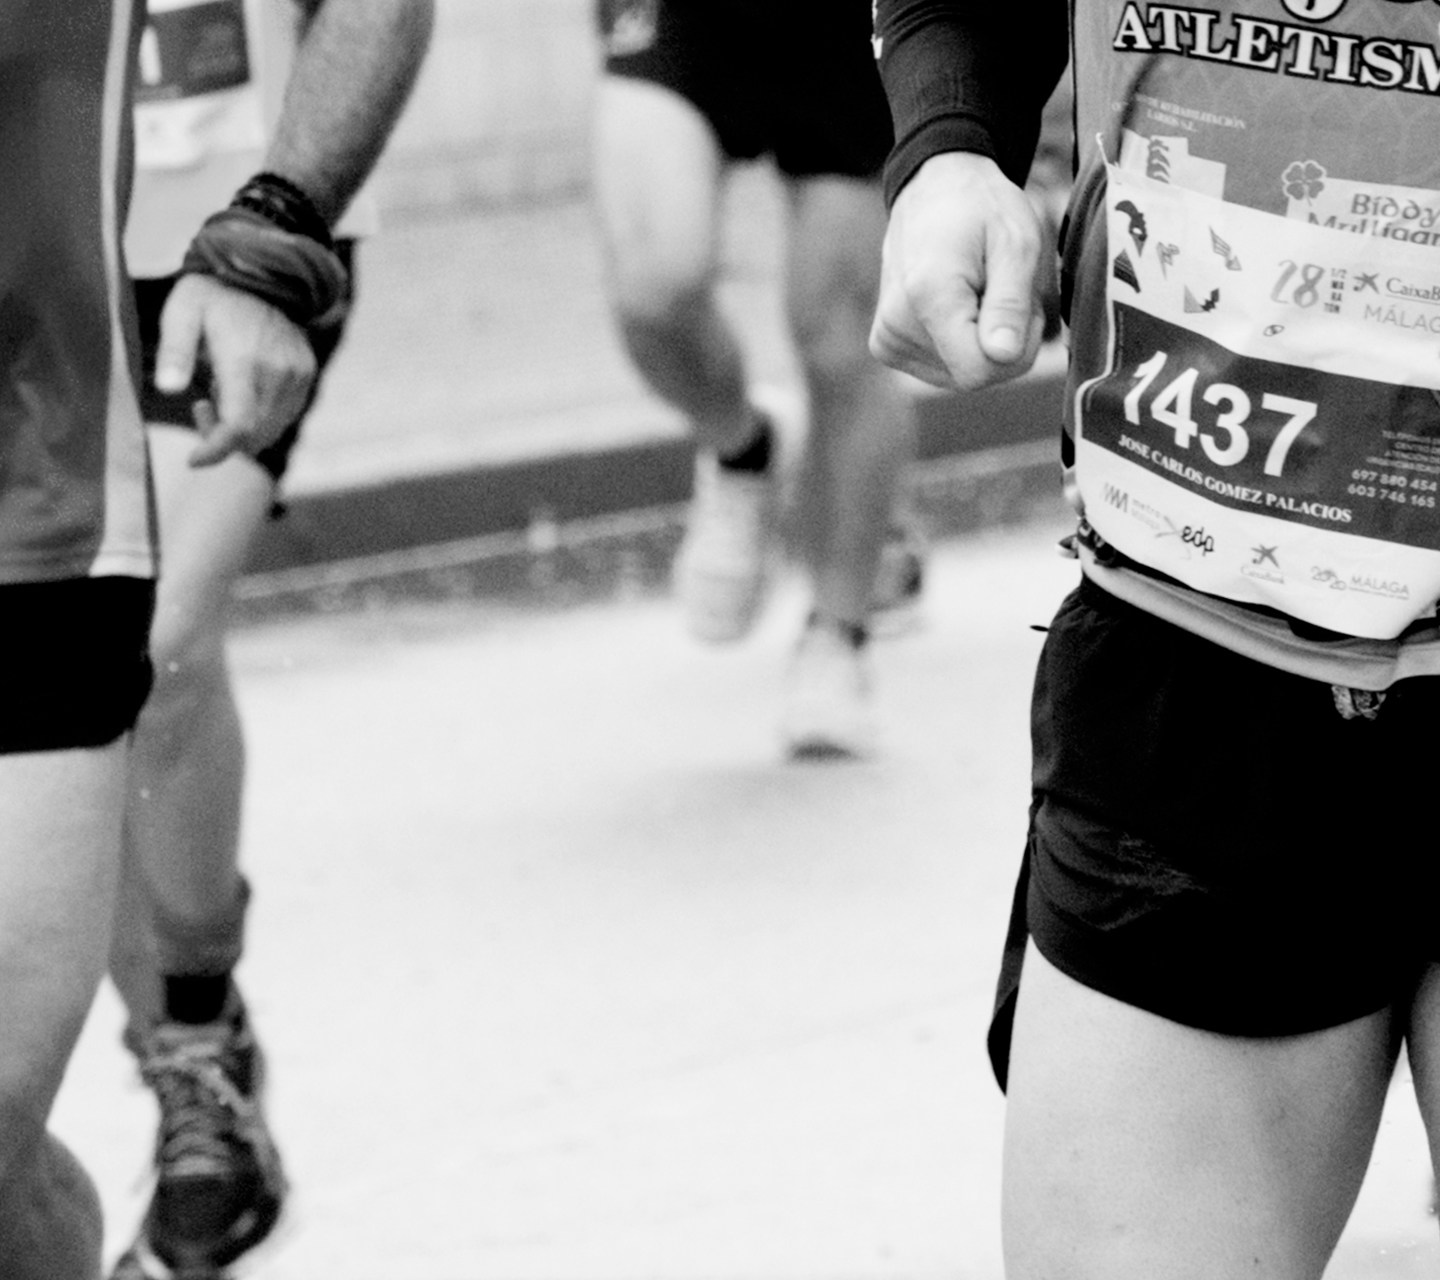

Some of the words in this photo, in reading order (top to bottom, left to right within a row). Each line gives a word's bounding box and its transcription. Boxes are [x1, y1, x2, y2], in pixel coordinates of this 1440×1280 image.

[1124, 350, 1318, 478] 1437
[1118, 434, 1150, 460] JOSE
[1151, 450, 1204, 485] CARLOS
[1204, 476, 1265, 506] GOMEZ
[1265, 492, 1353, 523] PALACIOS
[1351, 469, 1378, 482] 697
[1347, 483, 1376, 498] 603
[1380, 488, 1406, 504] 746
[1411, 494, 1436, 508] 165
[1181, 525, 1214, 557] edp
